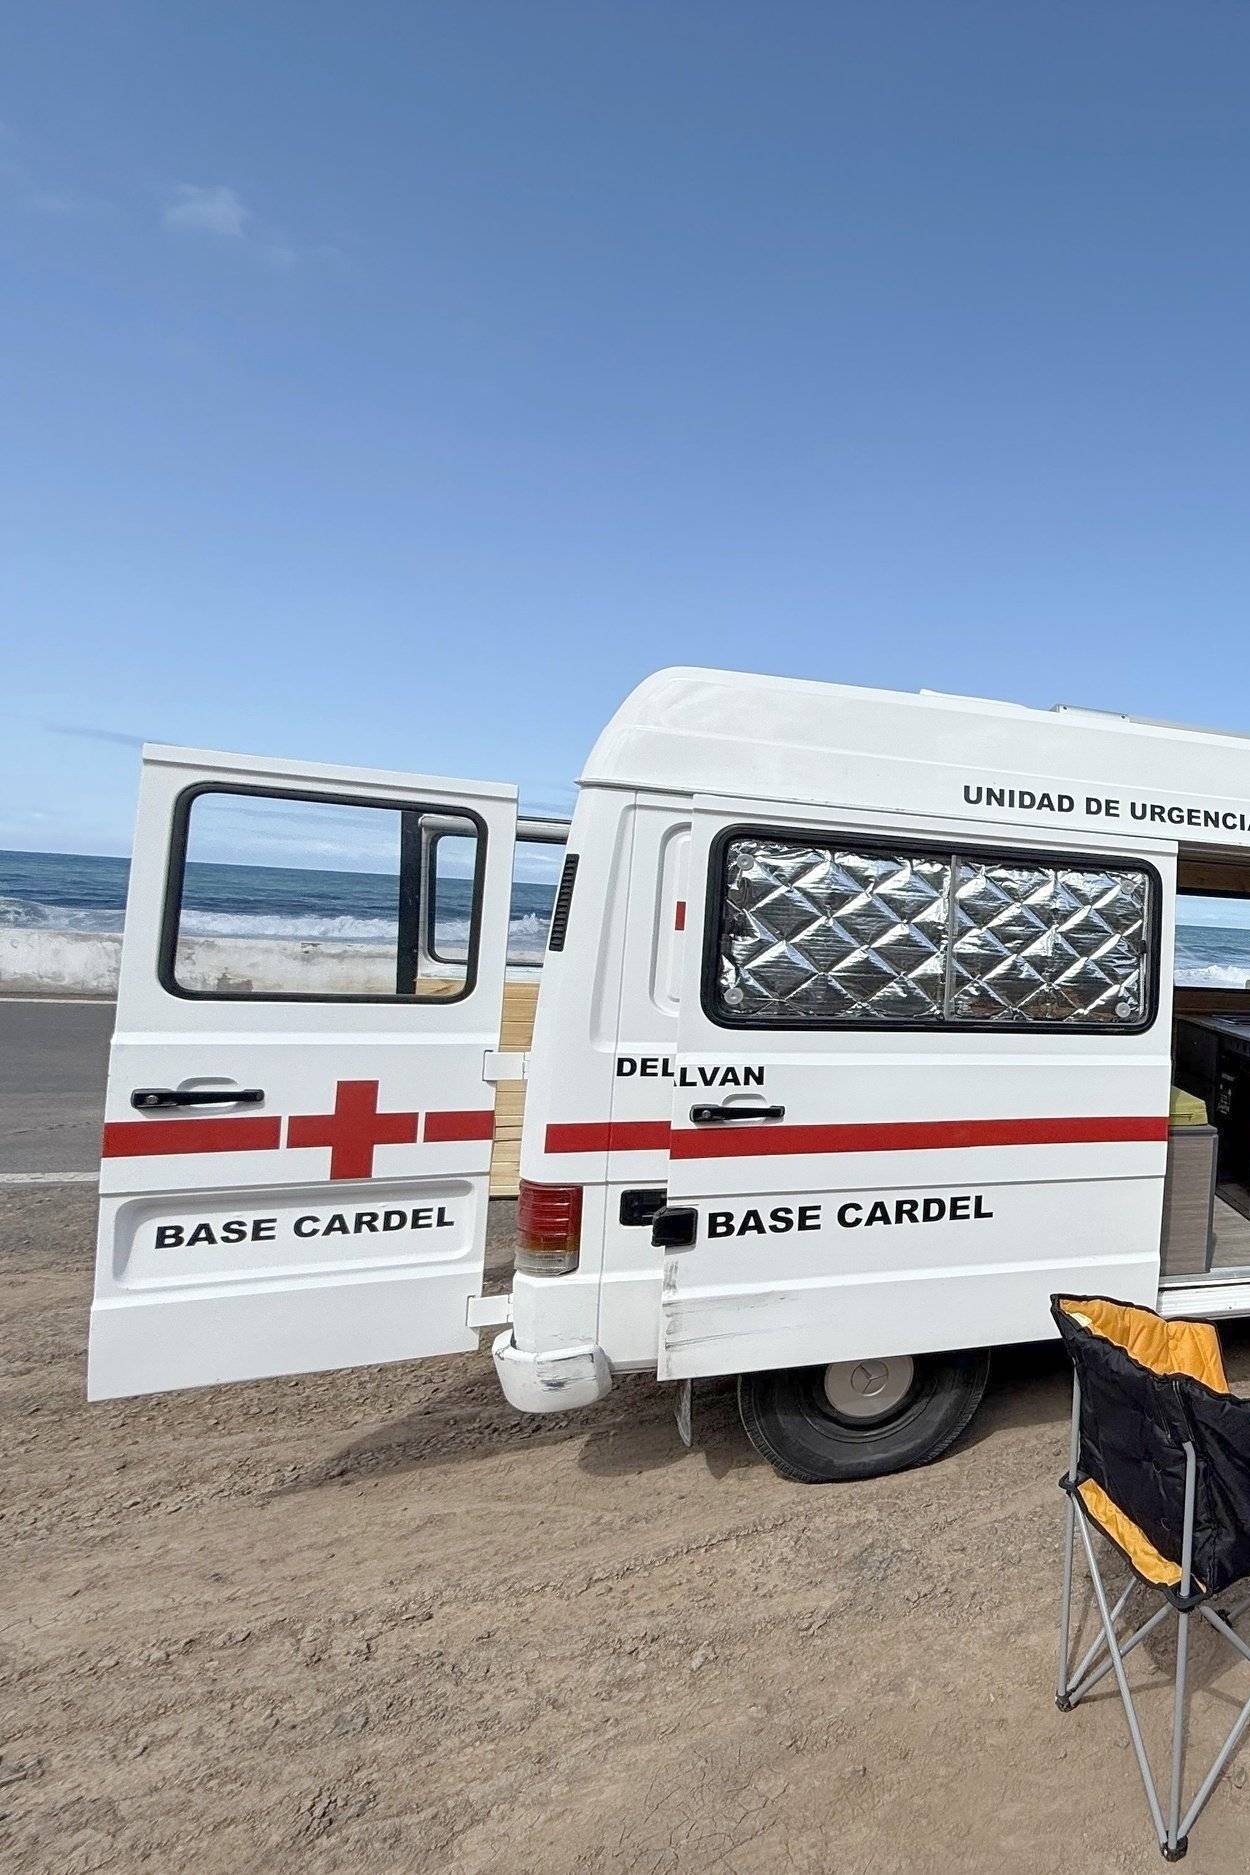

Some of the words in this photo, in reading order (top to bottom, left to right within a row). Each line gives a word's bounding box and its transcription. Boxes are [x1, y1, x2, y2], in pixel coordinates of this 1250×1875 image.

[962, 784, 1075, 813] UNIDAD
[1085, 796, 1121, 818] DE
[616, 1057, 675, 1077] DEL
[674, 1066, 765, 1087] LVAN
[154, 1217, 278, 1250] BASE
[293, 1206, 455, 1238] CARDEL
[707, 1204, 822, 1239] BASE
[836, 1194, 994, 1228] CARDEL
